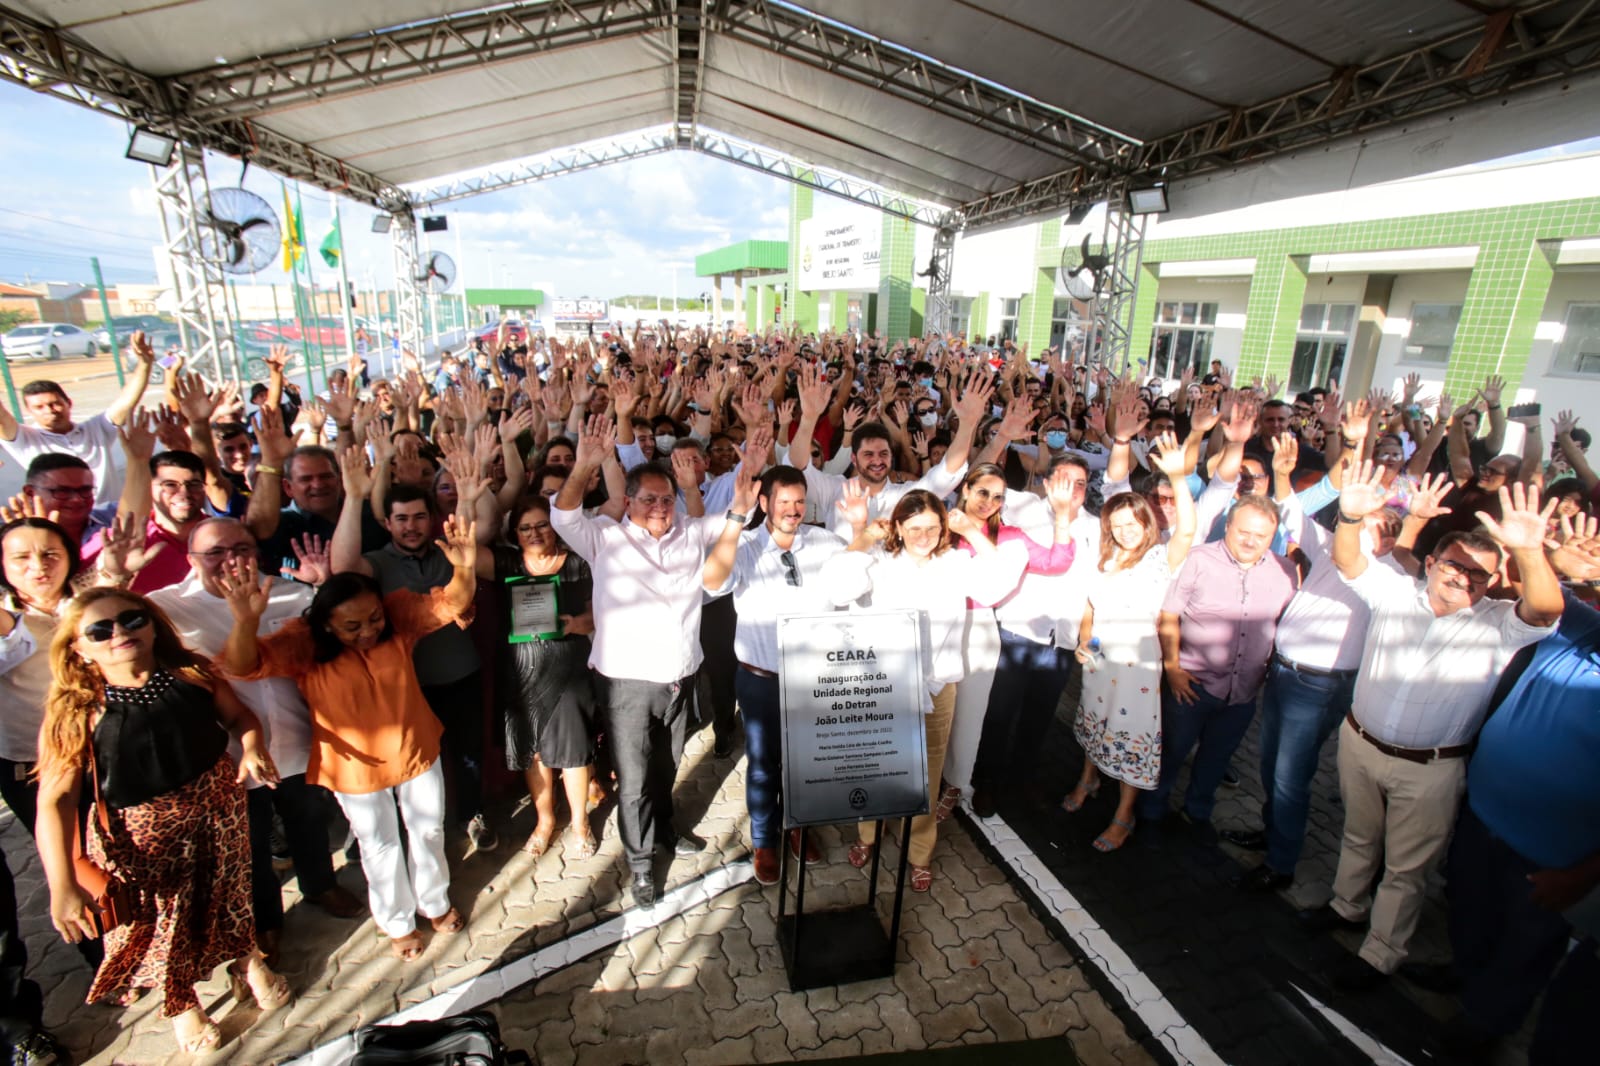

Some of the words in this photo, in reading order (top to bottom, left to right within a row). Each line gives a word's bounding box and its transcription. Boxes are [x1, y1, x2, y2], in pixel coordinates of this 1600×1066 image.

[826, 646, 876, 661] CEARÁ
[818, 672, 874, 685] Inauguração
[876, 671, 887, 680] da
[813, 687, 852, 698] Unidade
[853, 684, 893, 697] Regional
[831, 701, 843, 710] do
[845, 700, 877, 709] Detran
[815, 715, 837, 726] João
[839, 714, 863, 724] Leite
[865, 713, 894, 722] Moura
